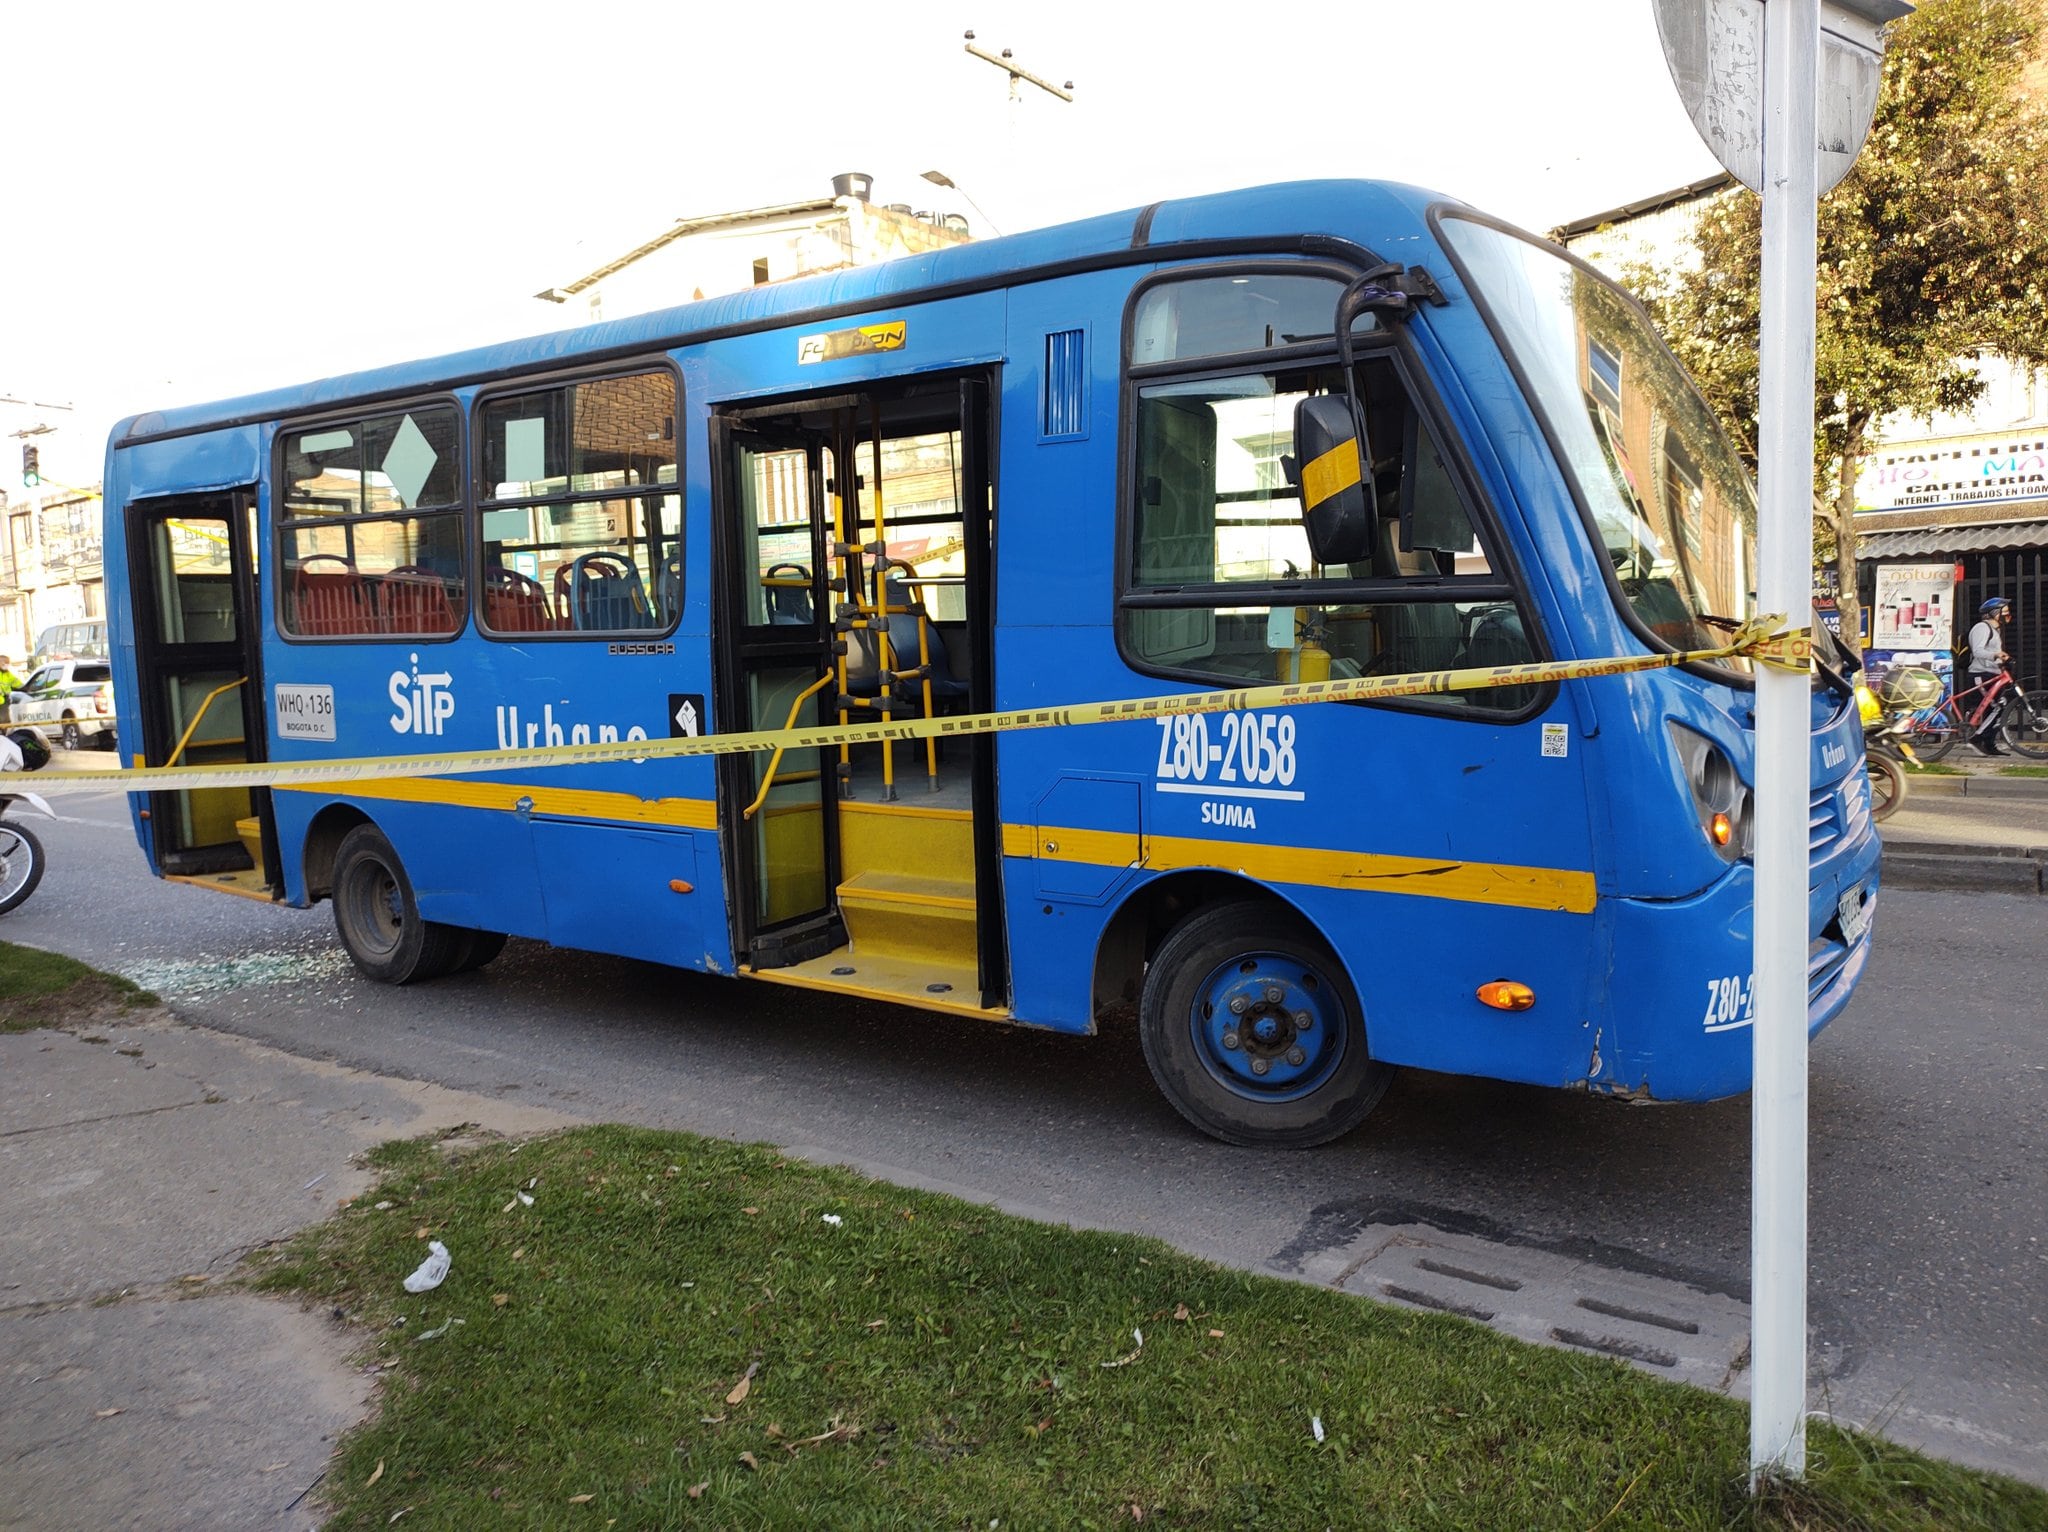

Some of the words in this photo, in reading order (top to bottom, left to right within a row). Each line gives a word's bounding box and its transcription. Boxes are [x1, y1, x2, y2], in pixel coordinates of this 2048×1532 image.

[1905, 473, 2045, 494] CAFETERIA
[1893, 494, 1940, 507] INTERNET
[1949, 488, 2003, 502] TRABAJOS
[2005, 486, 2018, 497] EN
[1890, 567, 1951, 581] natura
[608, 643, 676, 655] BUSSCAR
[1488, 673, 1535, 686] PASE
[1542, 669, 1568, 681] NO
[1156, 712, 1296, 787] Z80-2058
[1822, 744, 1846, 769] Urbano
[1201, 802, 1256, 830] SUMA
